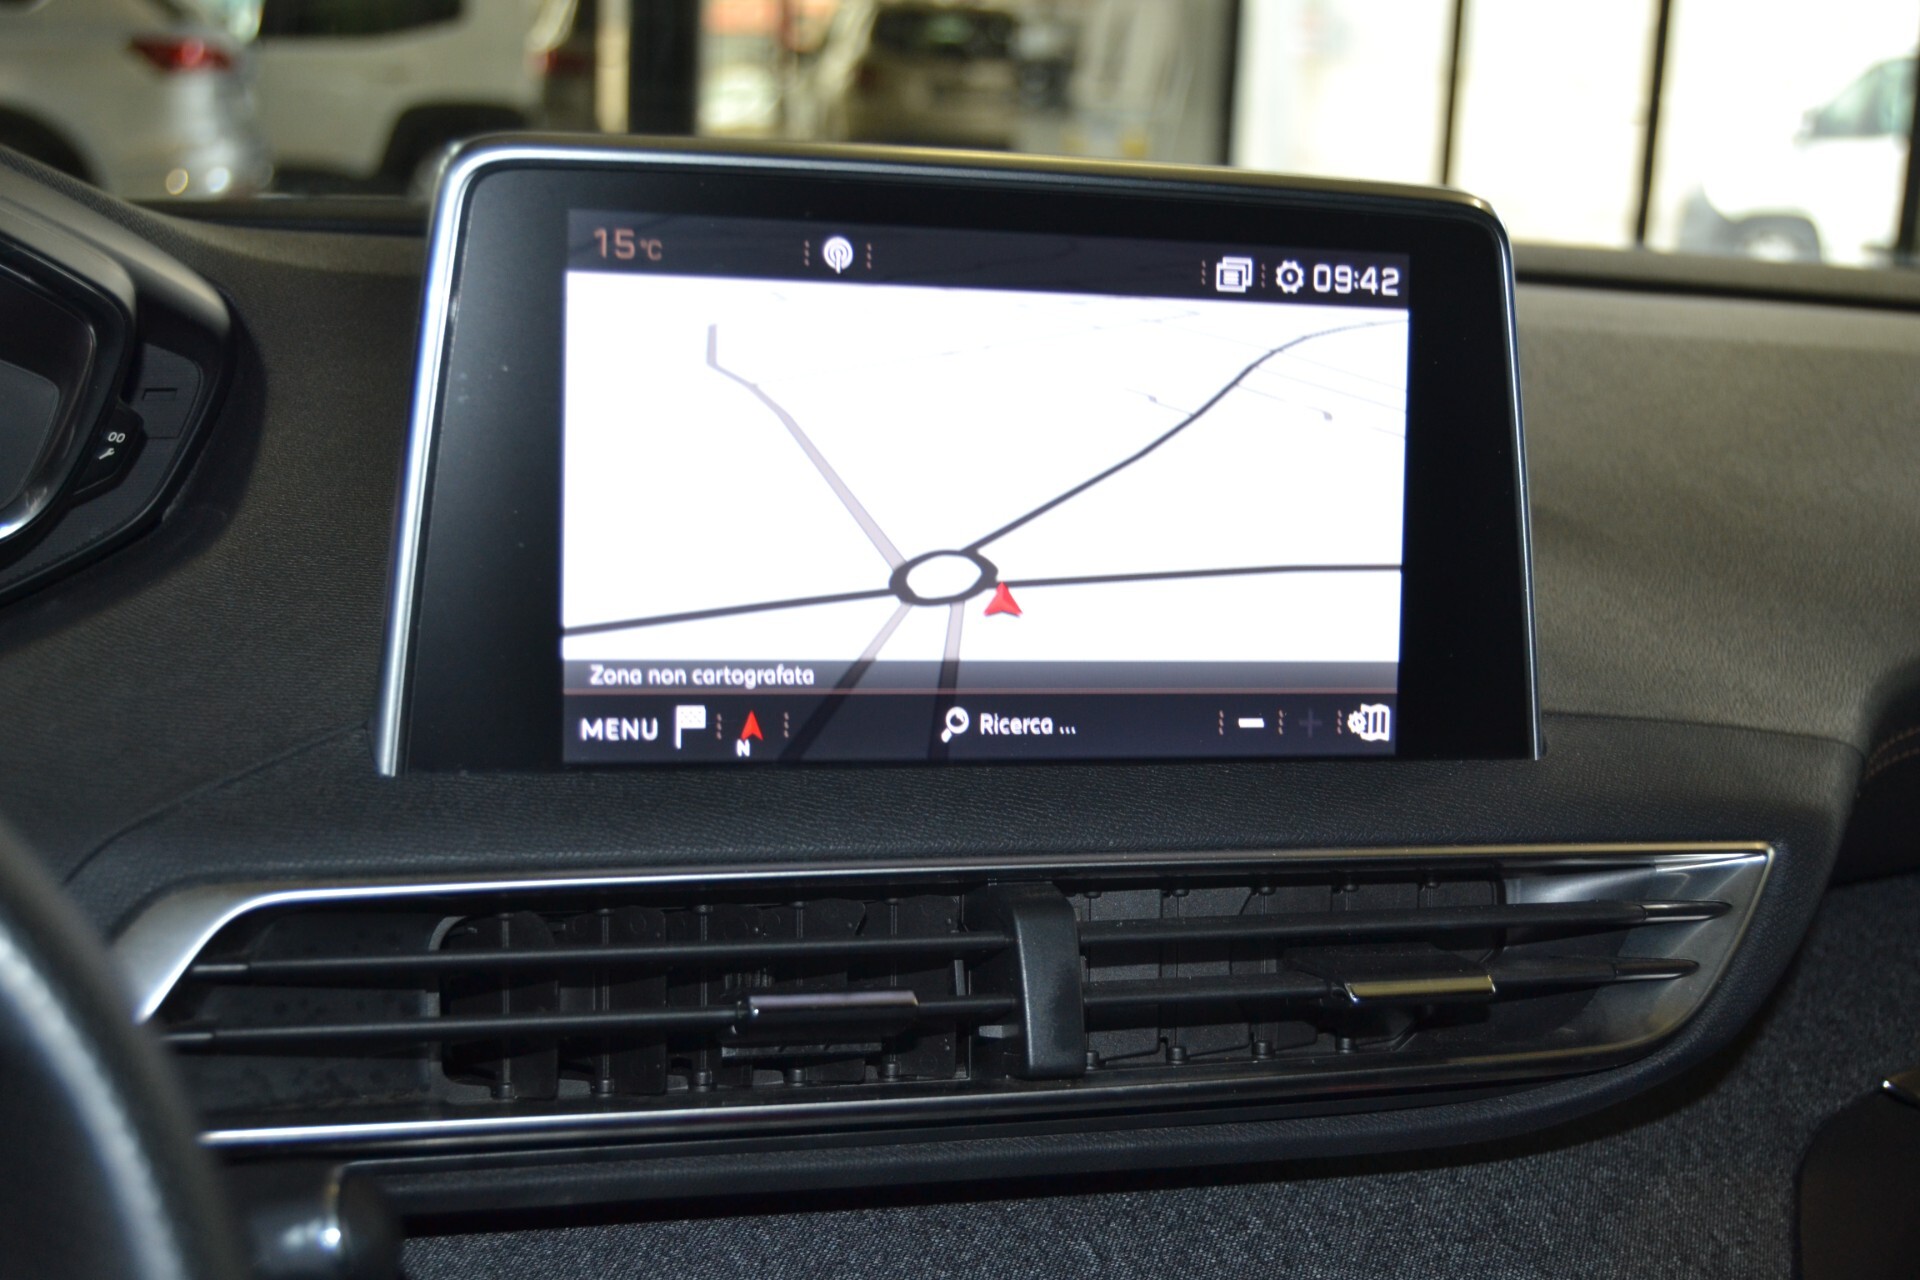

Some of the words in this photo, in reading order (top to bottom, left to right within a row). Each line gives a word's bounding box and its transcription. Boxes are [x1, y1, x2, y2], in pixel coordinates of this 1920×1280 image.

[1313, 263, 1400, 296] 09:42
[590, 664, 642, 686] Zona
[649, 668, 687, 686] non
[692, 664, 815, 690] cartografata
[580, 717, 658, 741] MENU
[979, 712, 1054, 736] Ricerca
[736, 739, 750, 757] N
